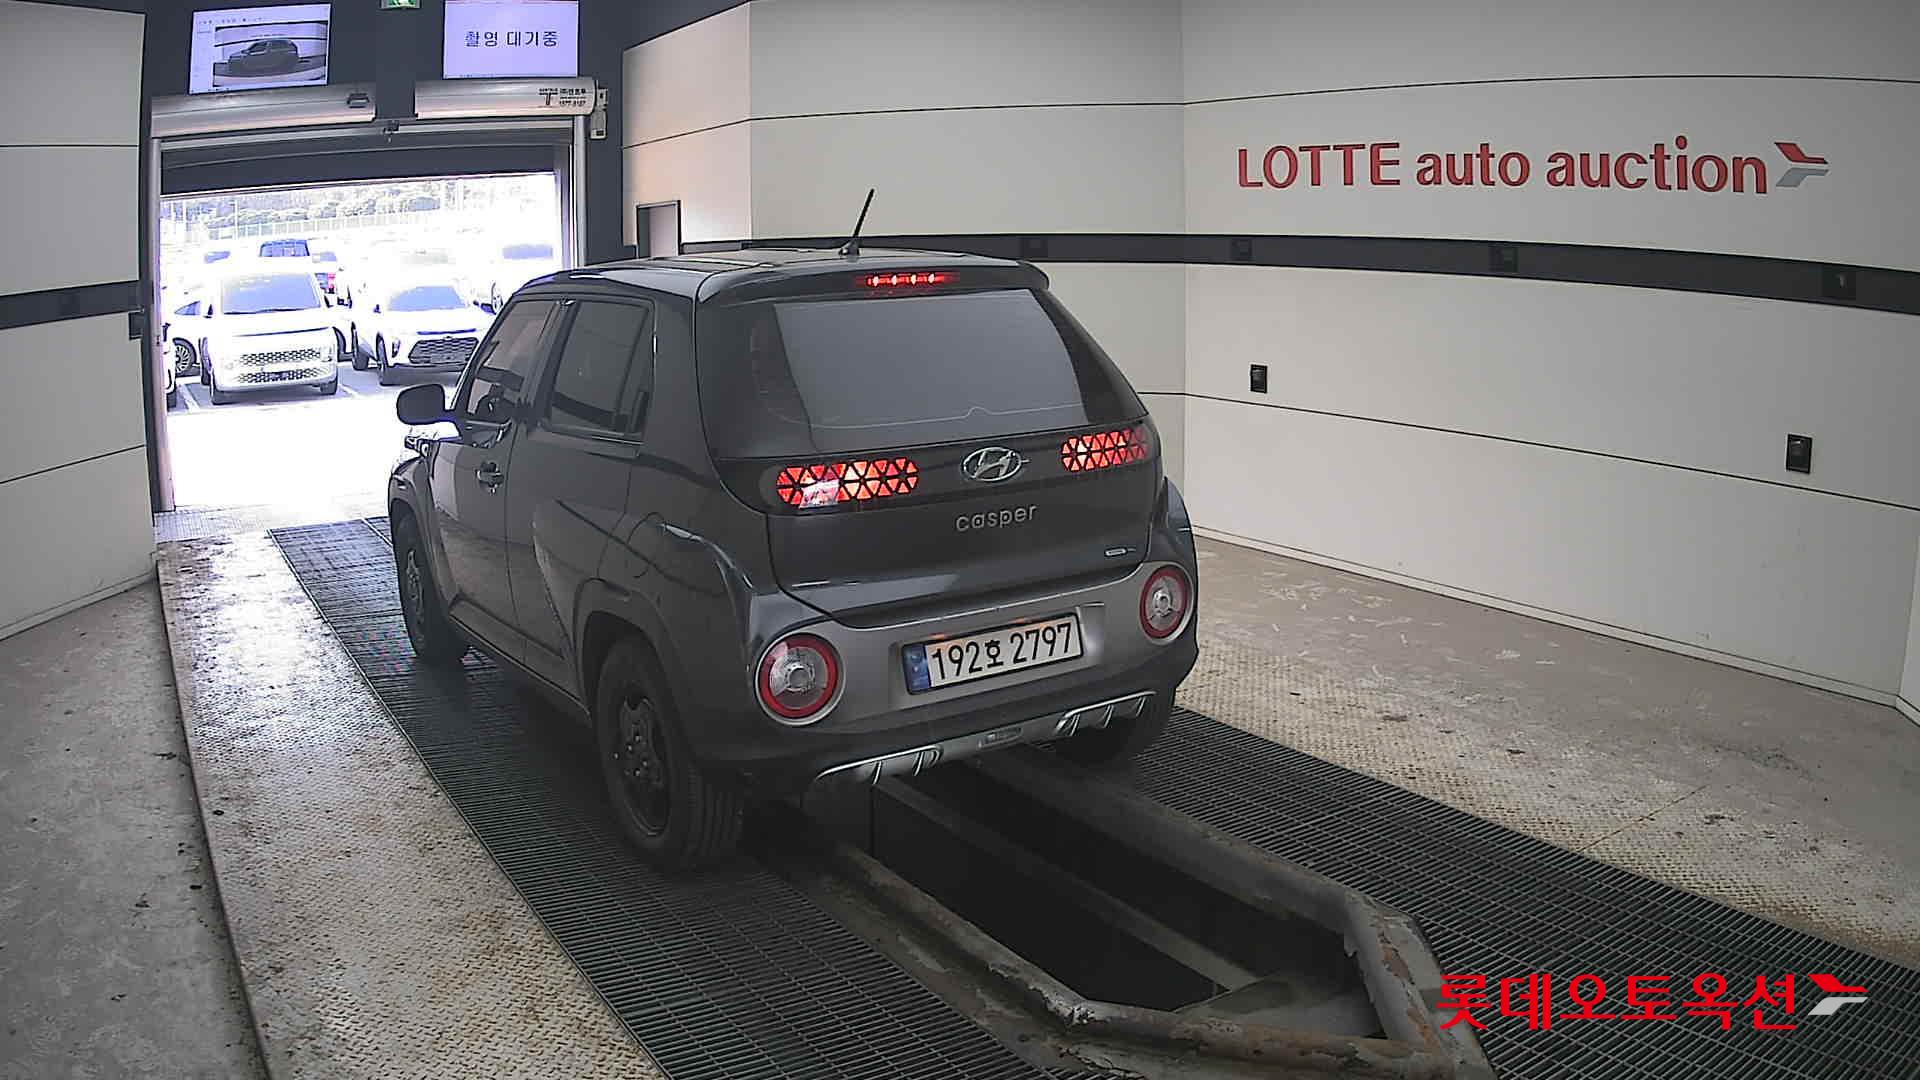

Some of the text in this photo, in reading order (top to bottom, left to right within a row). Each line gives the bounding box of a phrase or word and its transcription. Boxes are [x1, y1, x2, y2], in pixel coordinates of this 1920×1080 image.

[506, 30, 559, 48] 대기중
[1238, 135, 1767, 193] LOTTE auto auction
[955, 504, 1038, 532] casper
[931, 622, 1073, 680] 192호 2797
